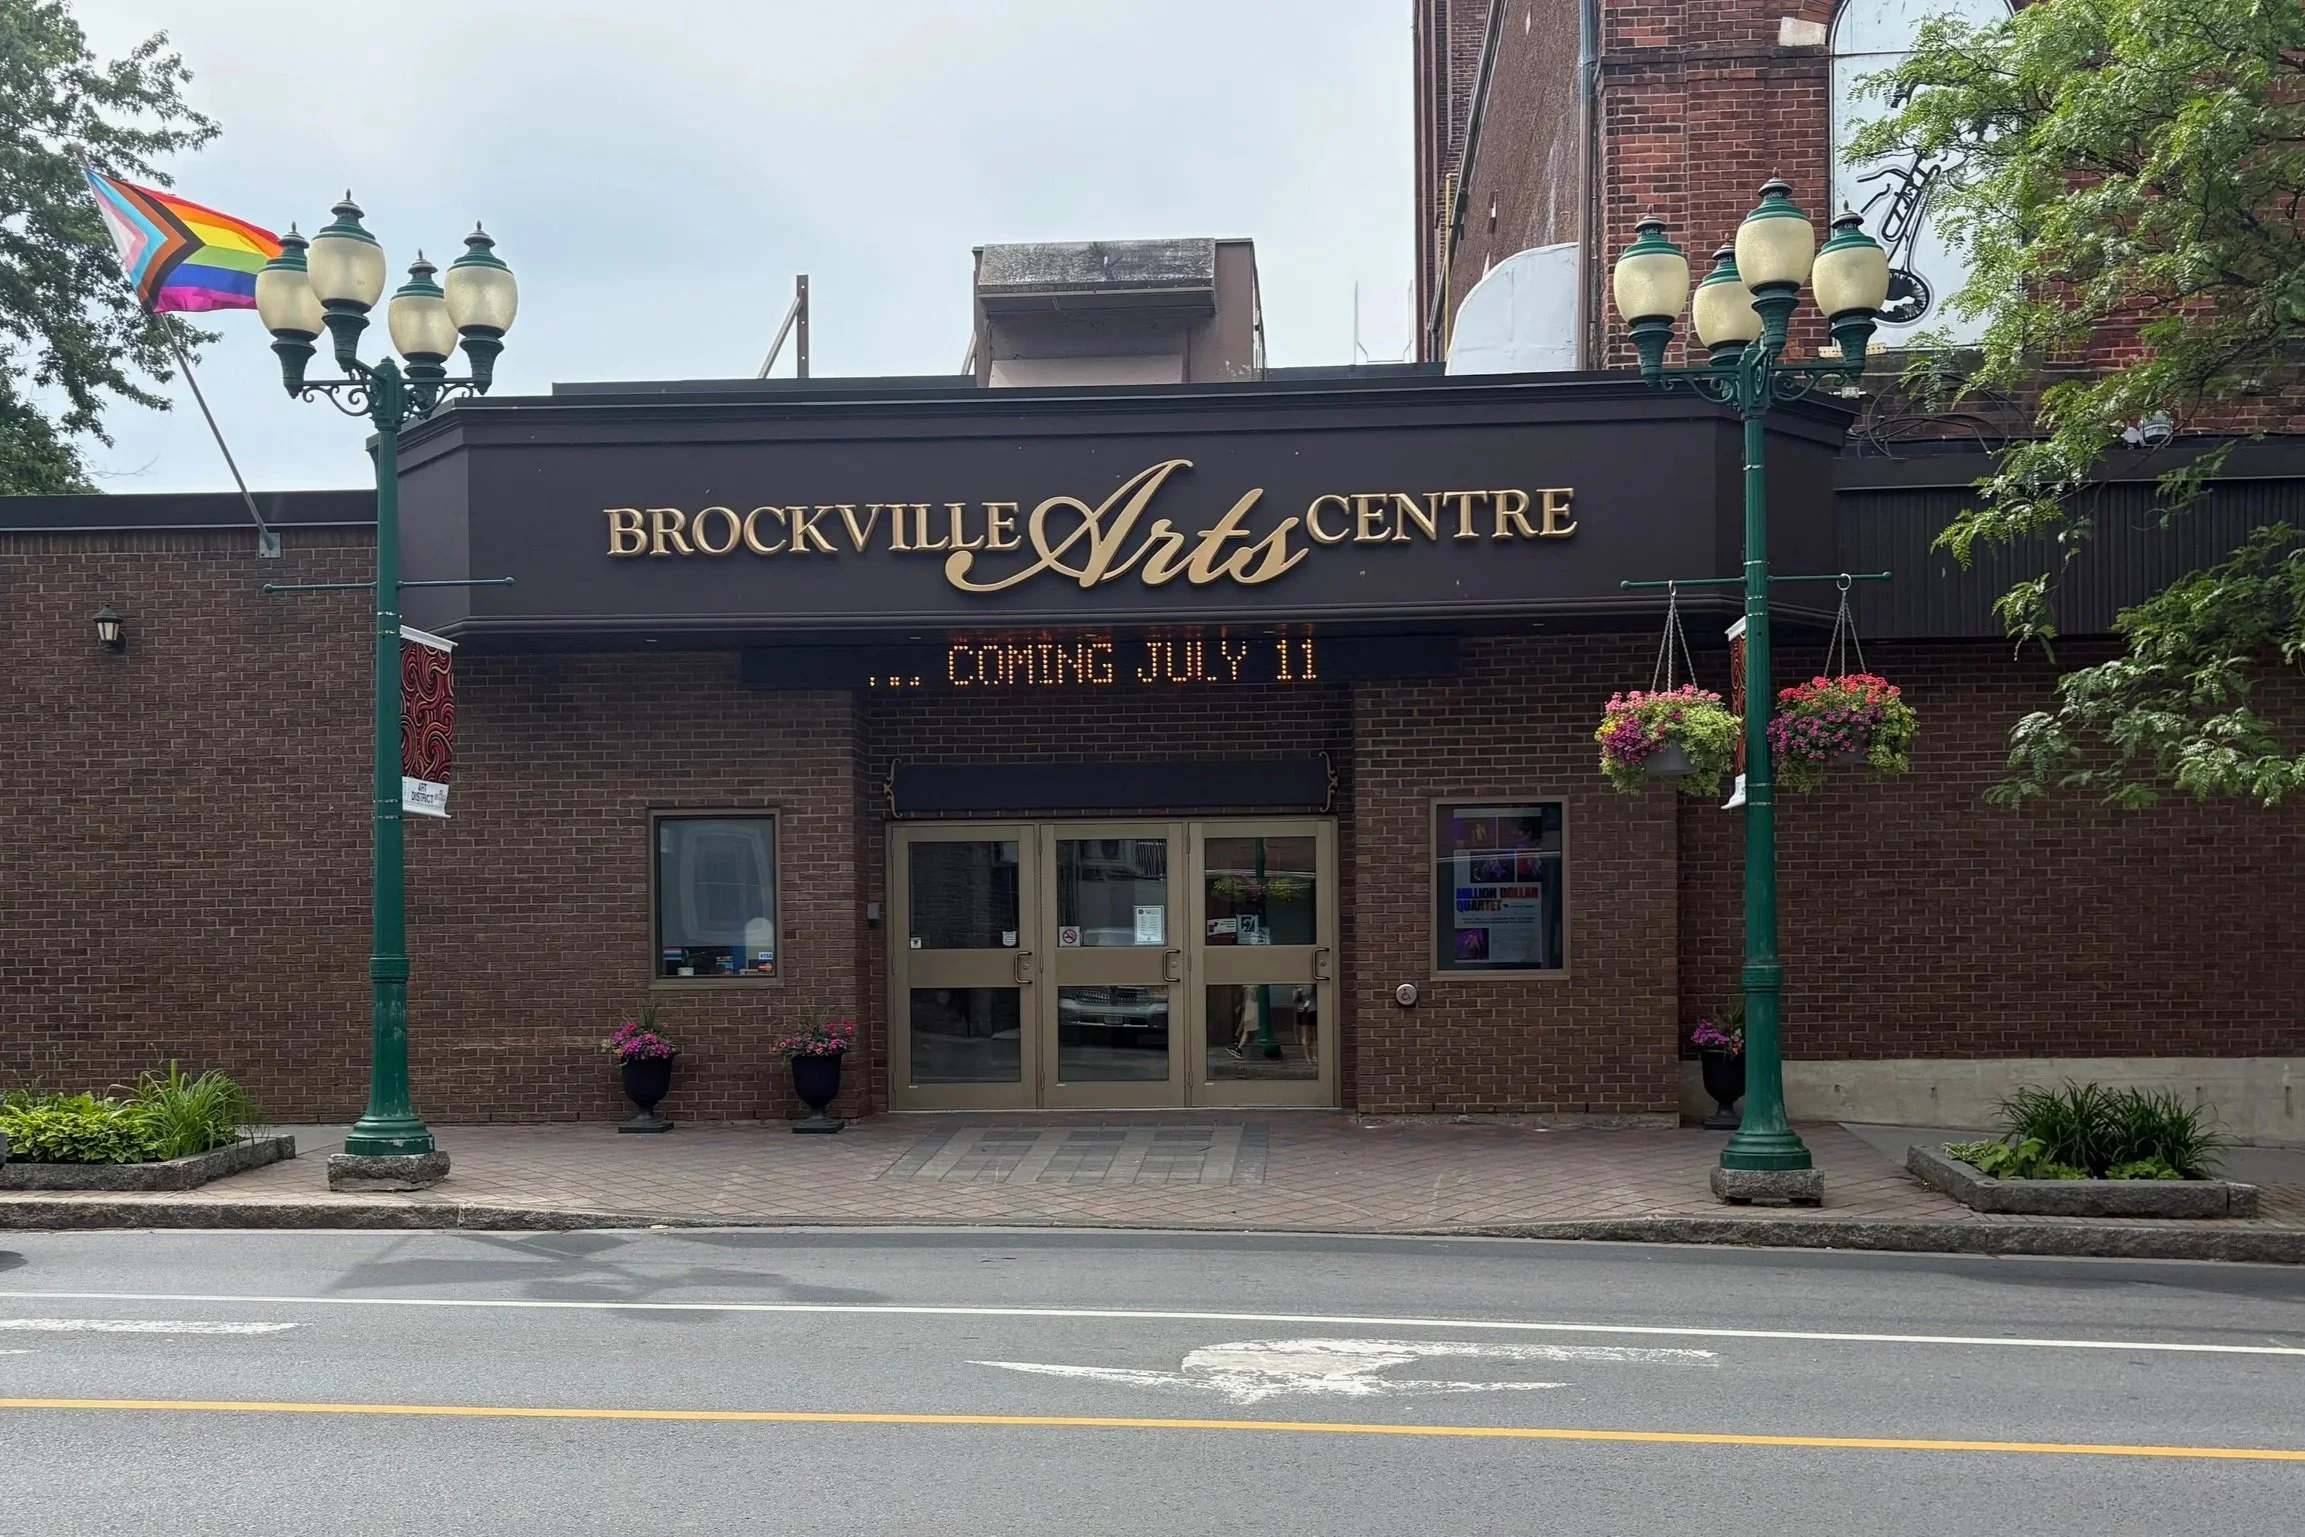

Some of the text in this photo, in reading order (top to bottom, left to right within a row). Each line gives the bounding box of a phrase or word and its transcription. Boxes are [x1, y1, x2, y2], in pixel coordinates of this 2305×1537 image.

[603, 459, 1578, 591] BROCKVILLE Arts CENTRE
[948, 644, 1113, 685] COMING
[1137, 640, 1247, 682] JULY
[1276, 638, 1317, 680] 11
[411, 791, 434, 804] DISTRICT
[418, 783, 428, 792] ART
